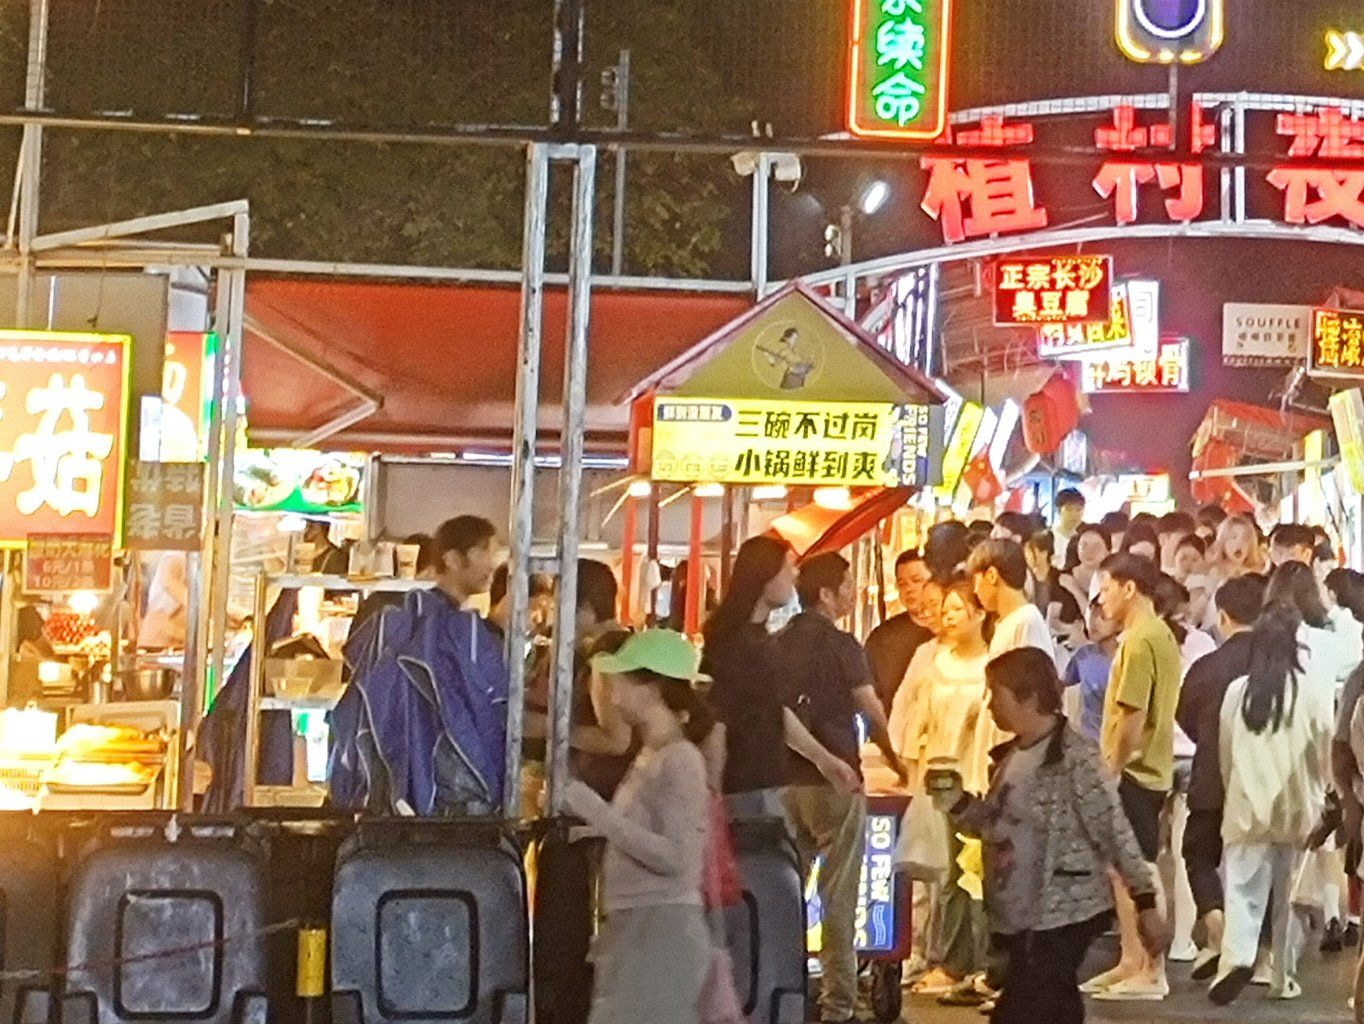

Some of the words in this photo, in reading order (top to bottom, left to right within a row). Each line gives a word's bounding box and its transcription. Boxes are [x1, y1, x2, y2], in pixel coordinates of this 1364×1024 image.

[1000, 260, 1104, 290] 正宗长沙
[1013, 290, 1090, 319] 臭豆腐
[1235, 317, 1301, 329] SOUFFLE
[735, 410, 879, 440] 三碗不过岗
[902, 404, 918, 486] FRIENDS
[734, 449, 879, 480] 小锅鲜到爽
[871, 817, 891, 849] SO
[870, 854, 892, 902] FEW
